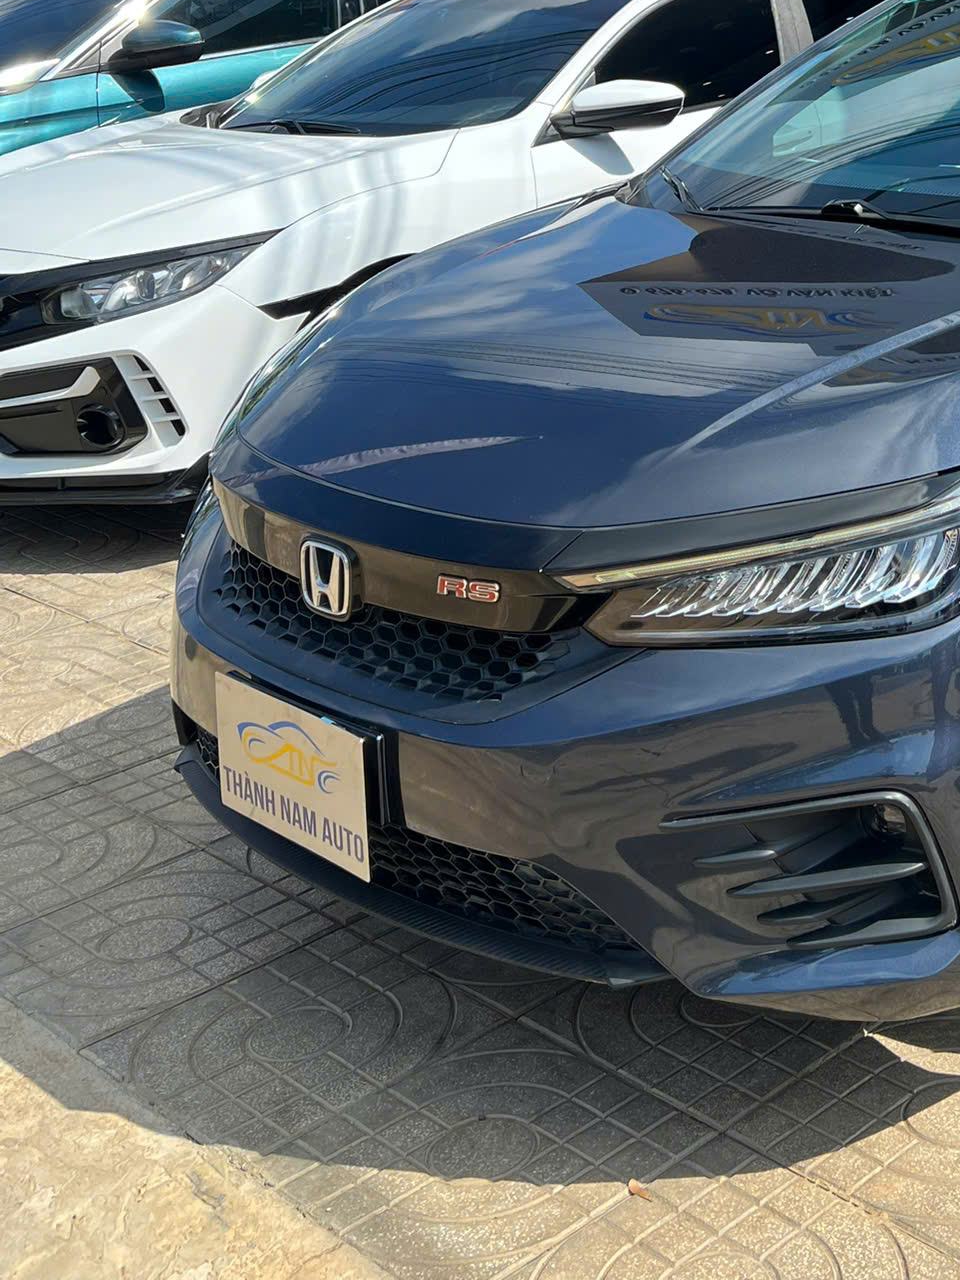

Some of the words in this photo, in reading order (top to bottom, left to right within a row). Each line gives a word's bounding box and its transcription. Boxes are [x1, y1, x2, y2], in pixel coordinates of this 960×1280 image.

[436, 575, 500, 603] RS
[223, 764, 276, 817] THÀNH
[280, 794, 317, 838] NAM
[322, 817, 365, 863] AUTO
